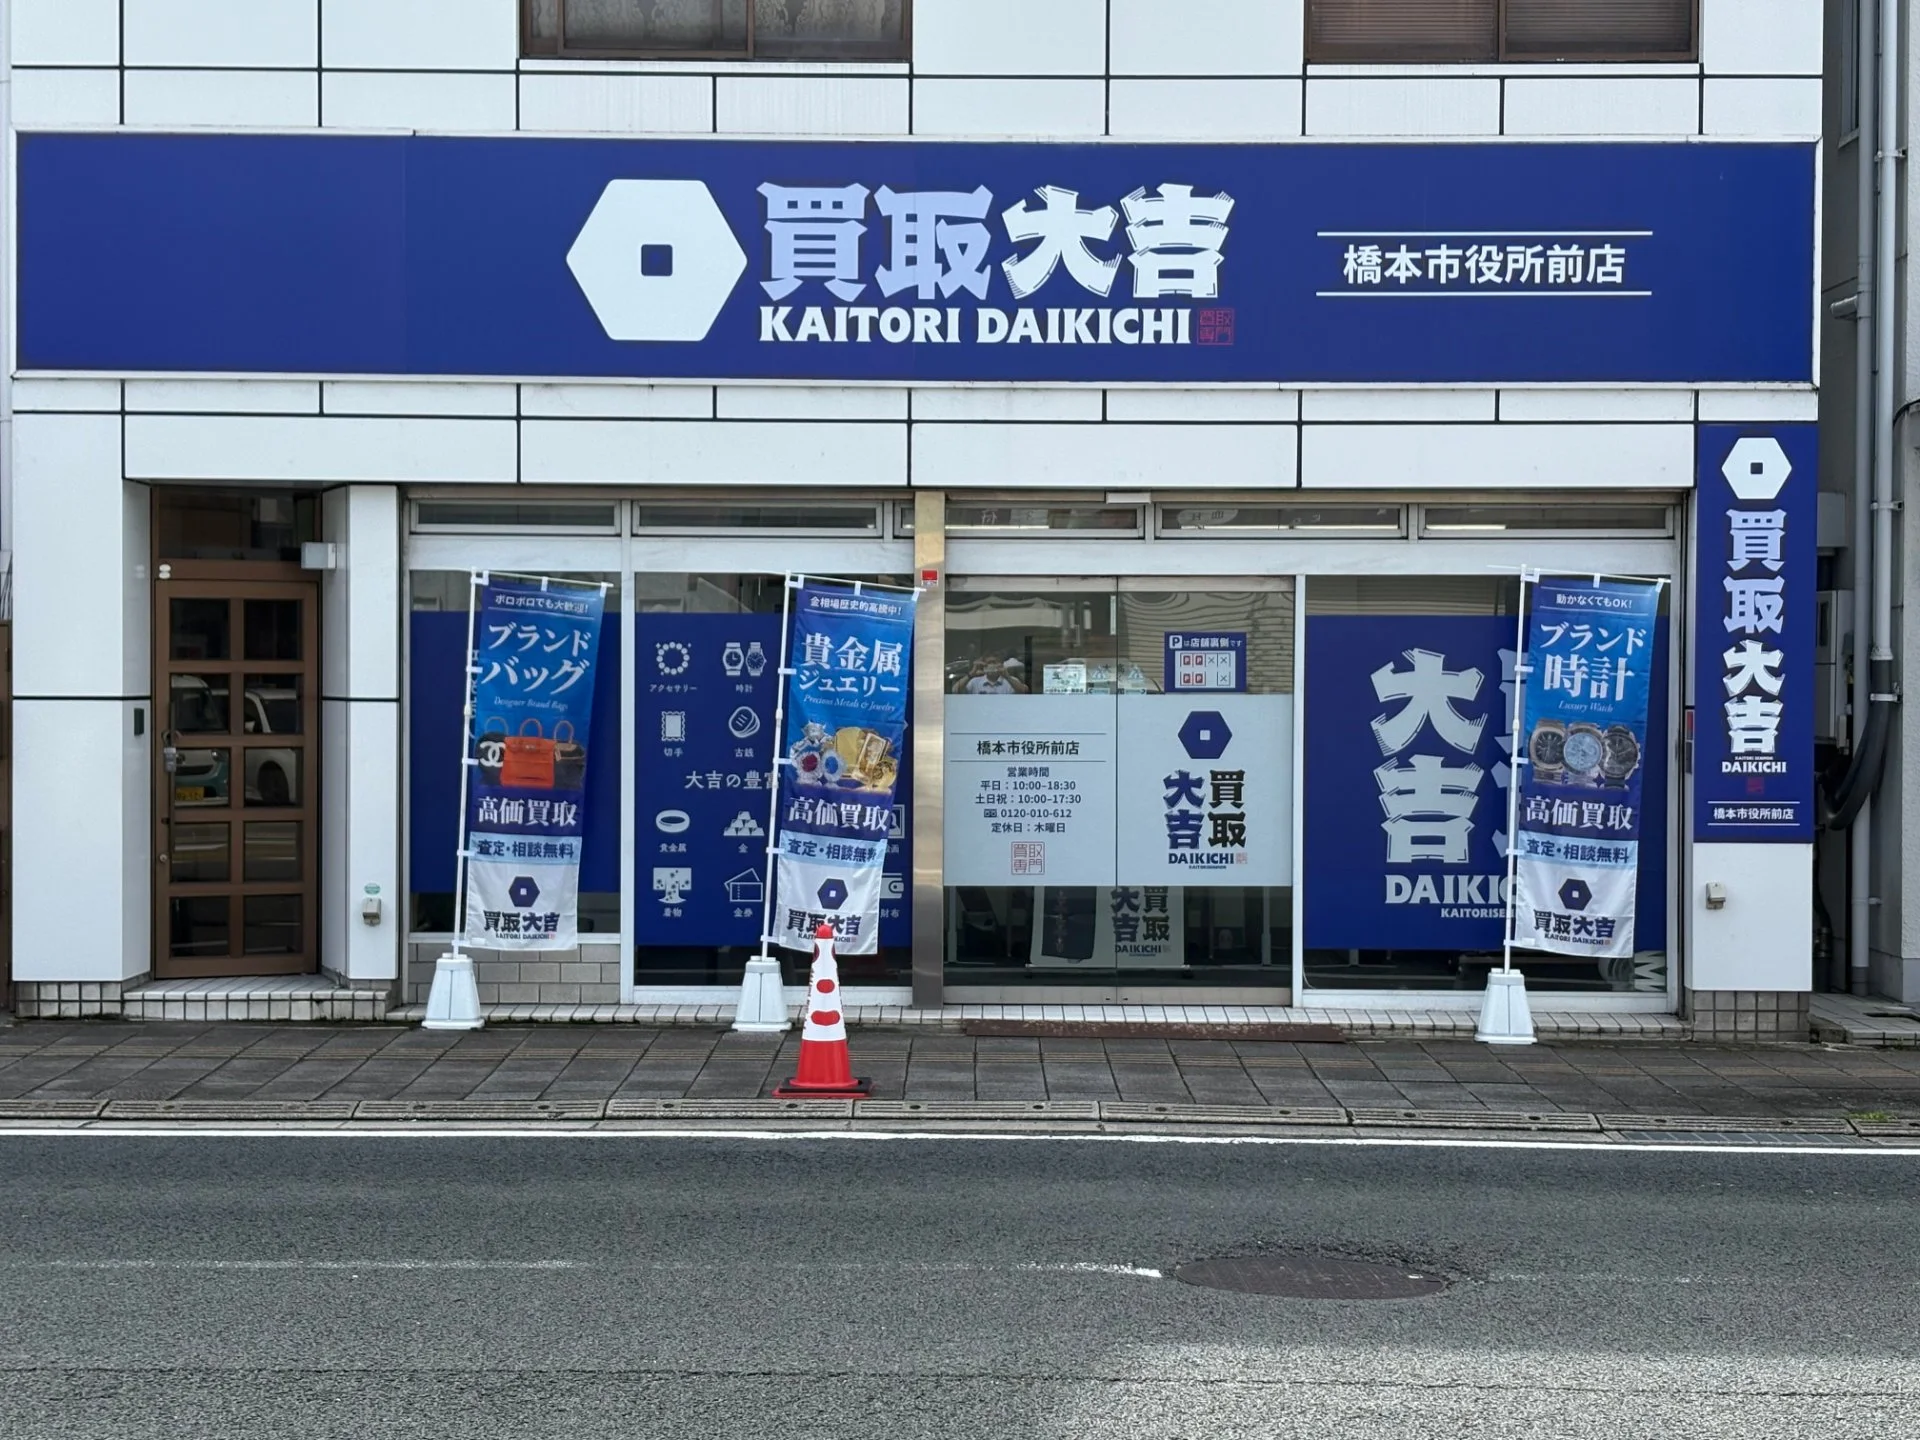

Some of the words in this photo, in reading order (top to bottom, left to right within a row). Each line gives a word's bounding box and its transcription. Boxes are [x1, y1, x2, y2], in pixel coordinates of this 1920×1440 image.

[756, 182, 1235, 302] 買取大吉
[1343, 244, 1626, 285] 橋本市役所前店
[759, 306, 961, 344] KAITORI
[976, 308, 1191, 345] DAIKICHI
[487, 621, 592, 657] ブランド
[1540, 621, 1647, 656] ブランド
[1723, 508, 1787, 753] 買取大吉
[800, 632, 903, 677] 貴金属
[481, 656, 590, 695] バッグ
[649, 683, 698, 693] アクセサリー
[799, 669, 900, 697] ジュエリー
[1543, 653, 1635, 702] 時計
[976, 740, 1080, 756] 橋本市役所前店
[1370, 648, 1488, 863] 大吉
[1007, 767, 1050, 778] 営業時間
[1722, 761, 1787, 773] DAIKICHI
[478, 796, 578, 827] 高価買取
[788, 796, 889, 831] 高価買取
[1000, 808, 1072, 818] 0120-010-612
[1163, 769, 1206, 850] 大吉
[1208, 770, 1246, 848] 買取
[1526, 796, 1633, 831] 高価買取
[1713, 808, 1794, 820] 橋本市役所前店
[1168, 852, 1234, 865] DAIKICHI
[1526, 838, 1629, 864] 査定・相談無料
[483, 910, 560, 932] 買取大吉
[1534, 909, 1616, 939] 買取大吉
